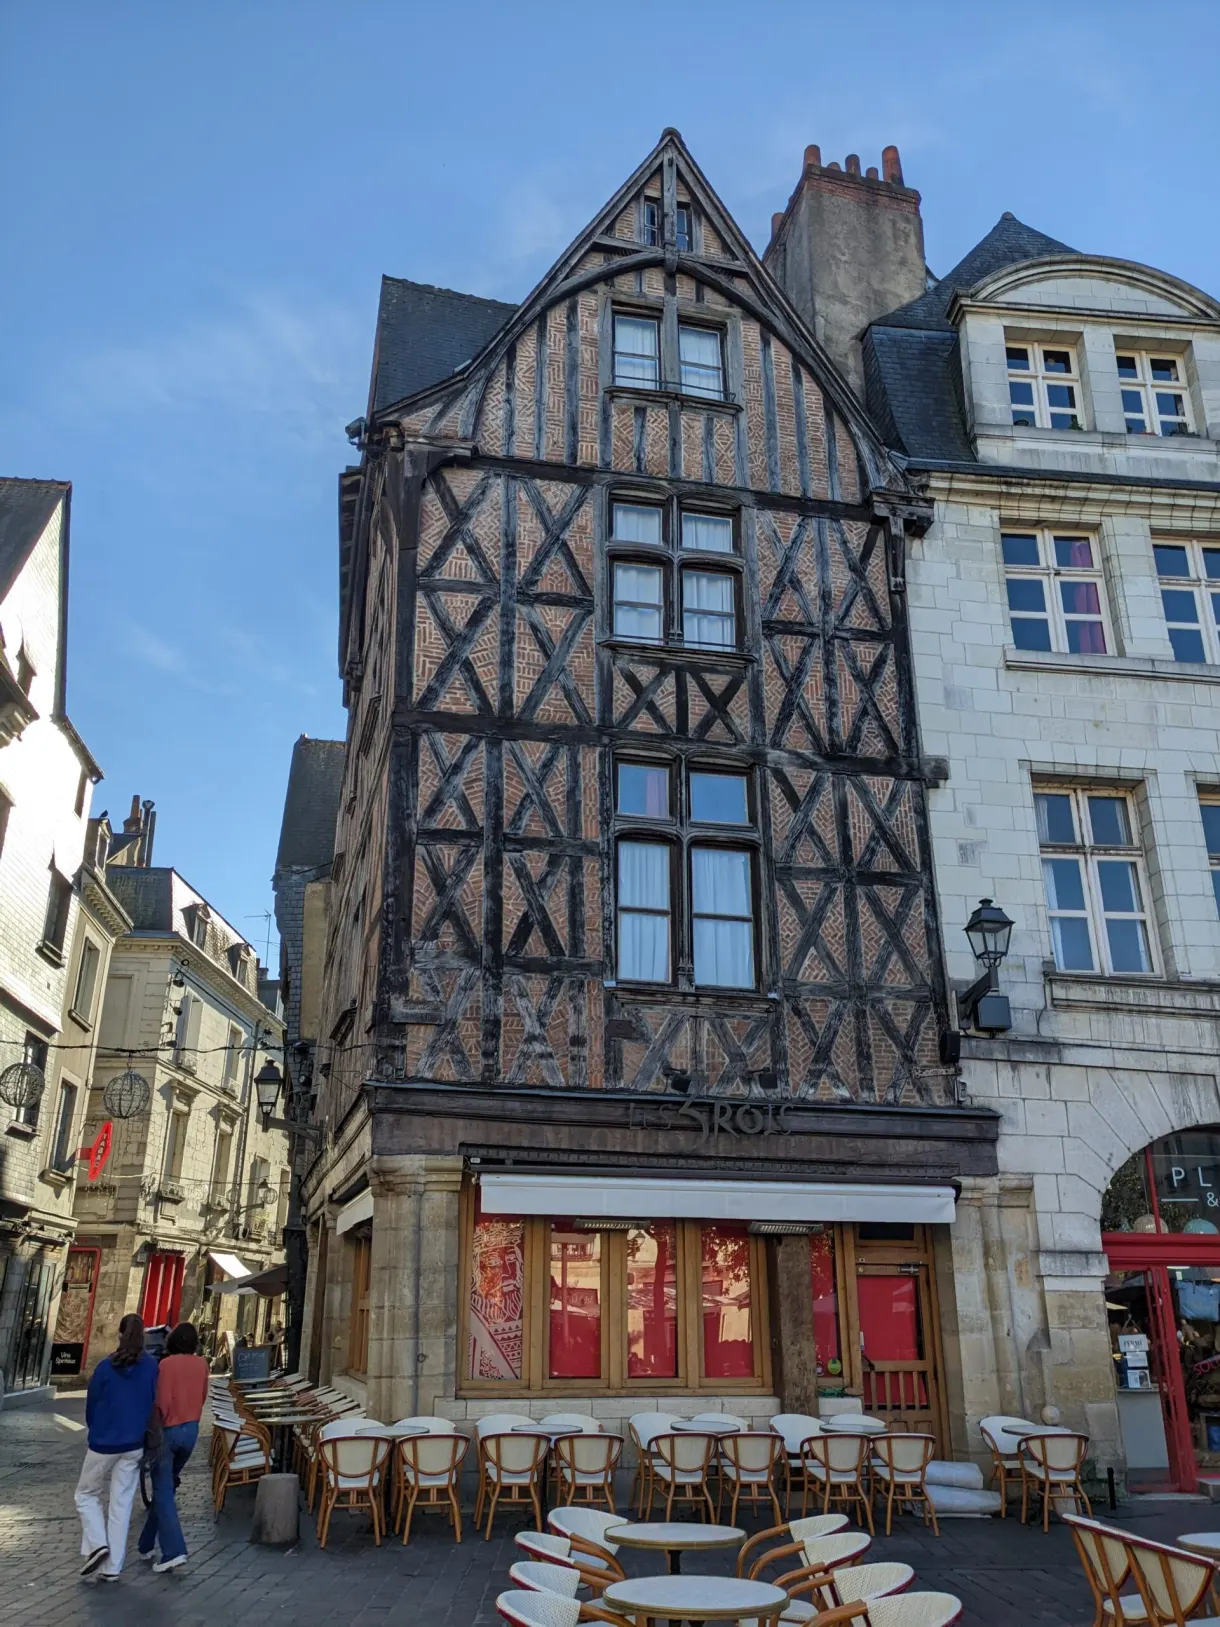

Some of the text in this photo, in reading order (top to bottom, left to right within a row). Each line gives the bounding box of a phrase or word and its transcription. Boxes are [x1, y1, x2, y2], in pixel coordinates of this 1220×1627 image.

[629, 1103, 674, 1130] LES
[713, 1101, 795, 1139] ROIS
[94, 1133, 108, 1168] TABAC
[1206, 1191, 1219, 1208] &
